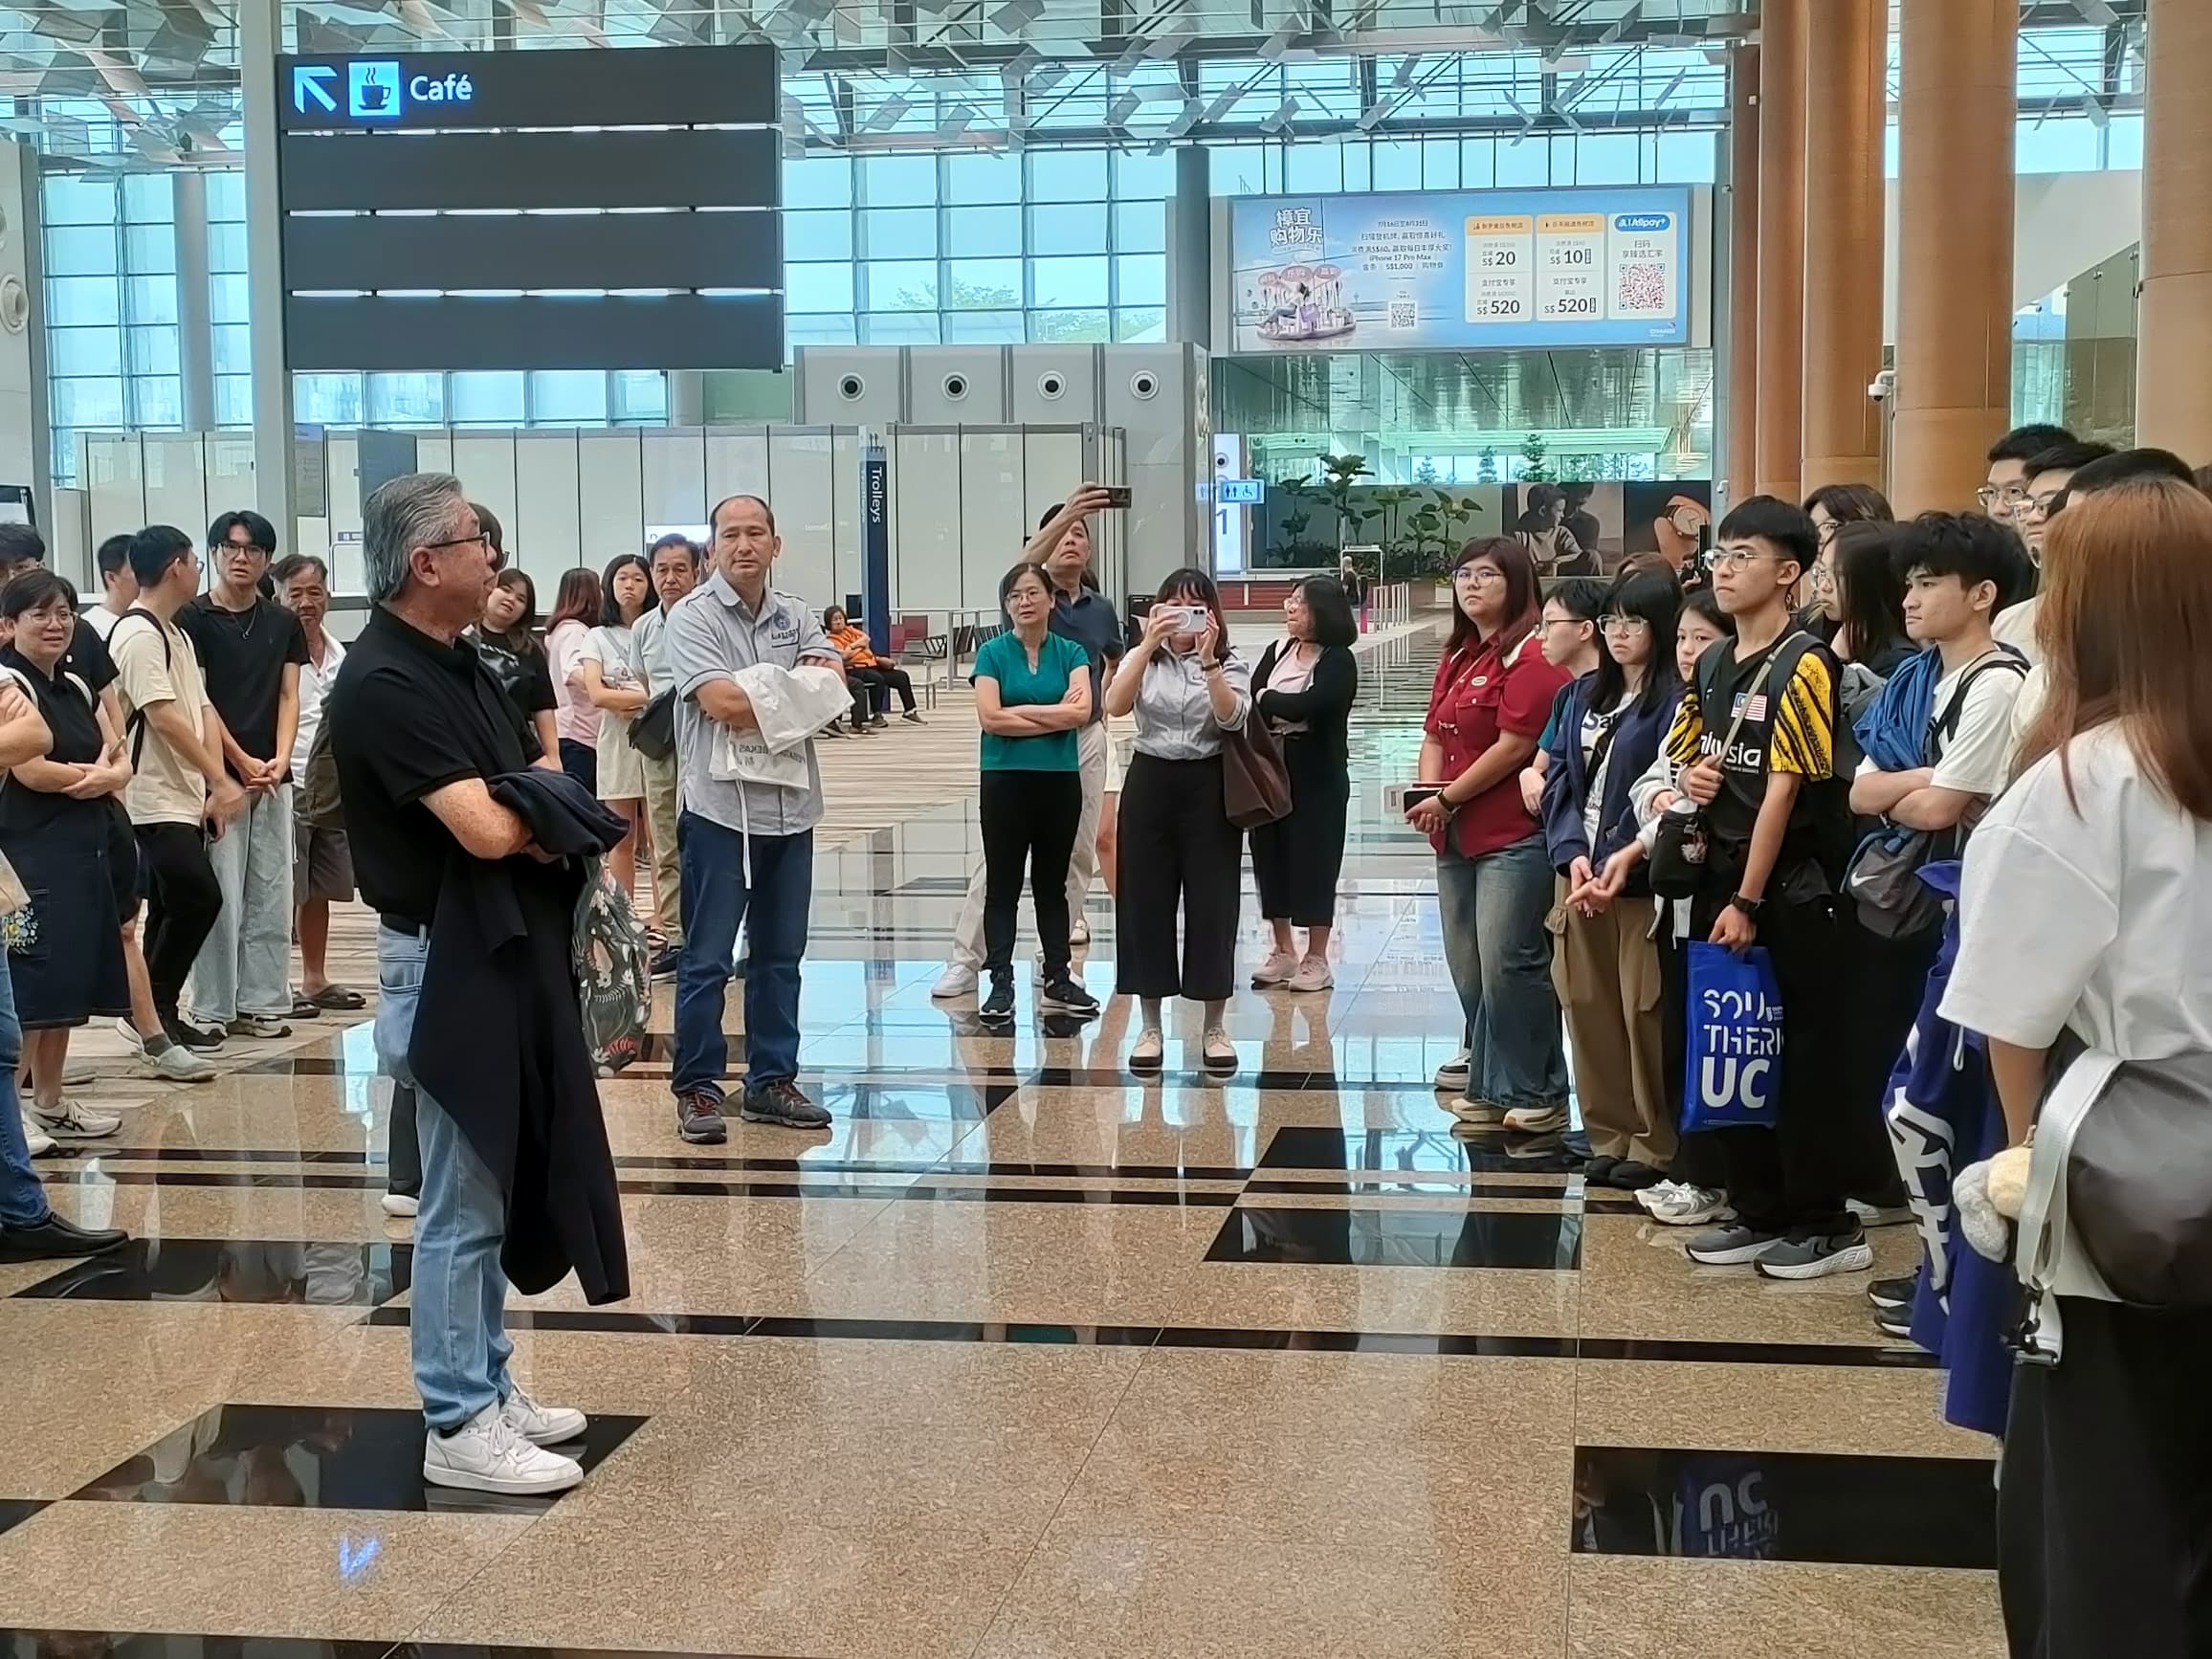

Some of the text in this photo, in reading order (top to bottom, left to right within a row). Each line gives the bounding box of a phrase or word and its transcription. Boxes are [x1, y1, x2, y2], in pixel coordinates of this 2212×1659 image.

[409, 74, 473, 100] Café
[1275, 208, 1312, 228] 樟宜
[1270, 226, 1323, 246] 购物乐
[1481, 251, 1515, 266] S$ 20
[1549, 255, 1561, 265] S$
[1564, 250, 1582, 264] 10
[1476, 299, 1520, 315] S$ 520
[1544, 305, 1556, 314] S$
[1558, 298, 1587, 313] 520
[870, 466, 883, 524] Trolleys
[1215, 508, 1228, 536] 1
[1703, 988, 1765, 1021] SOU
[1701, 1056, 1770, 1109] UC
